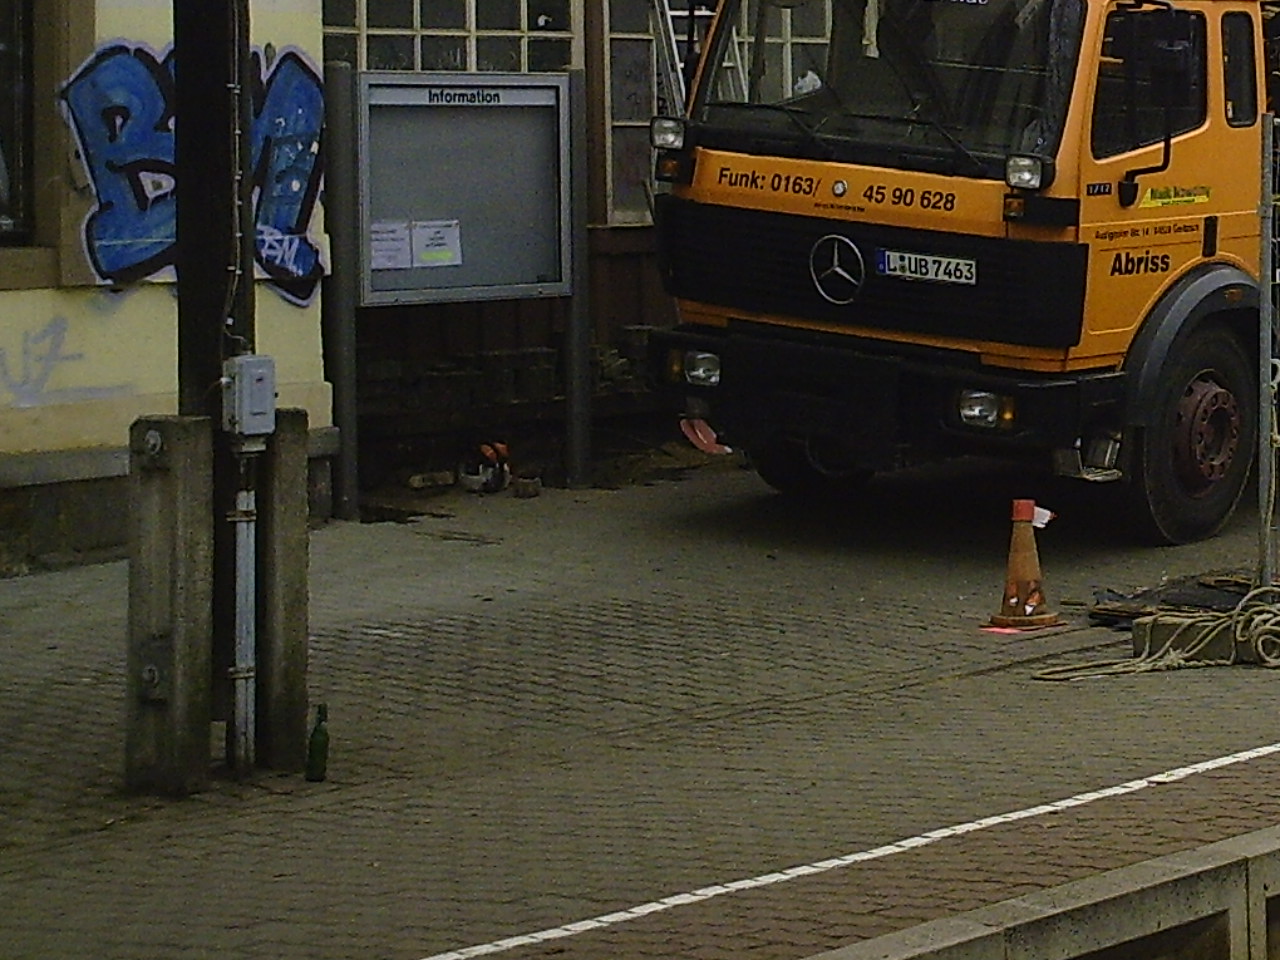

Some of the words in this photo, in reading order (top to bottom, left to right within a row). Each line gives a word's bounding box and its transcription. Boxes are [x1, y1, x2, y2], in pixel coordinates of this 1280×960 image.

[428, 89, 501, 104] Information
[717, 167, 766, 190] Funk:
[771, 173, 822, 198] 0163/
[862, 184, 886, 204] 45
[891, 187, 915, 207] 90
[919, 190, 956, 212] 628
[931, 259, 974, 281] 7463
[1109, 250, 1171, 276] Abriss
